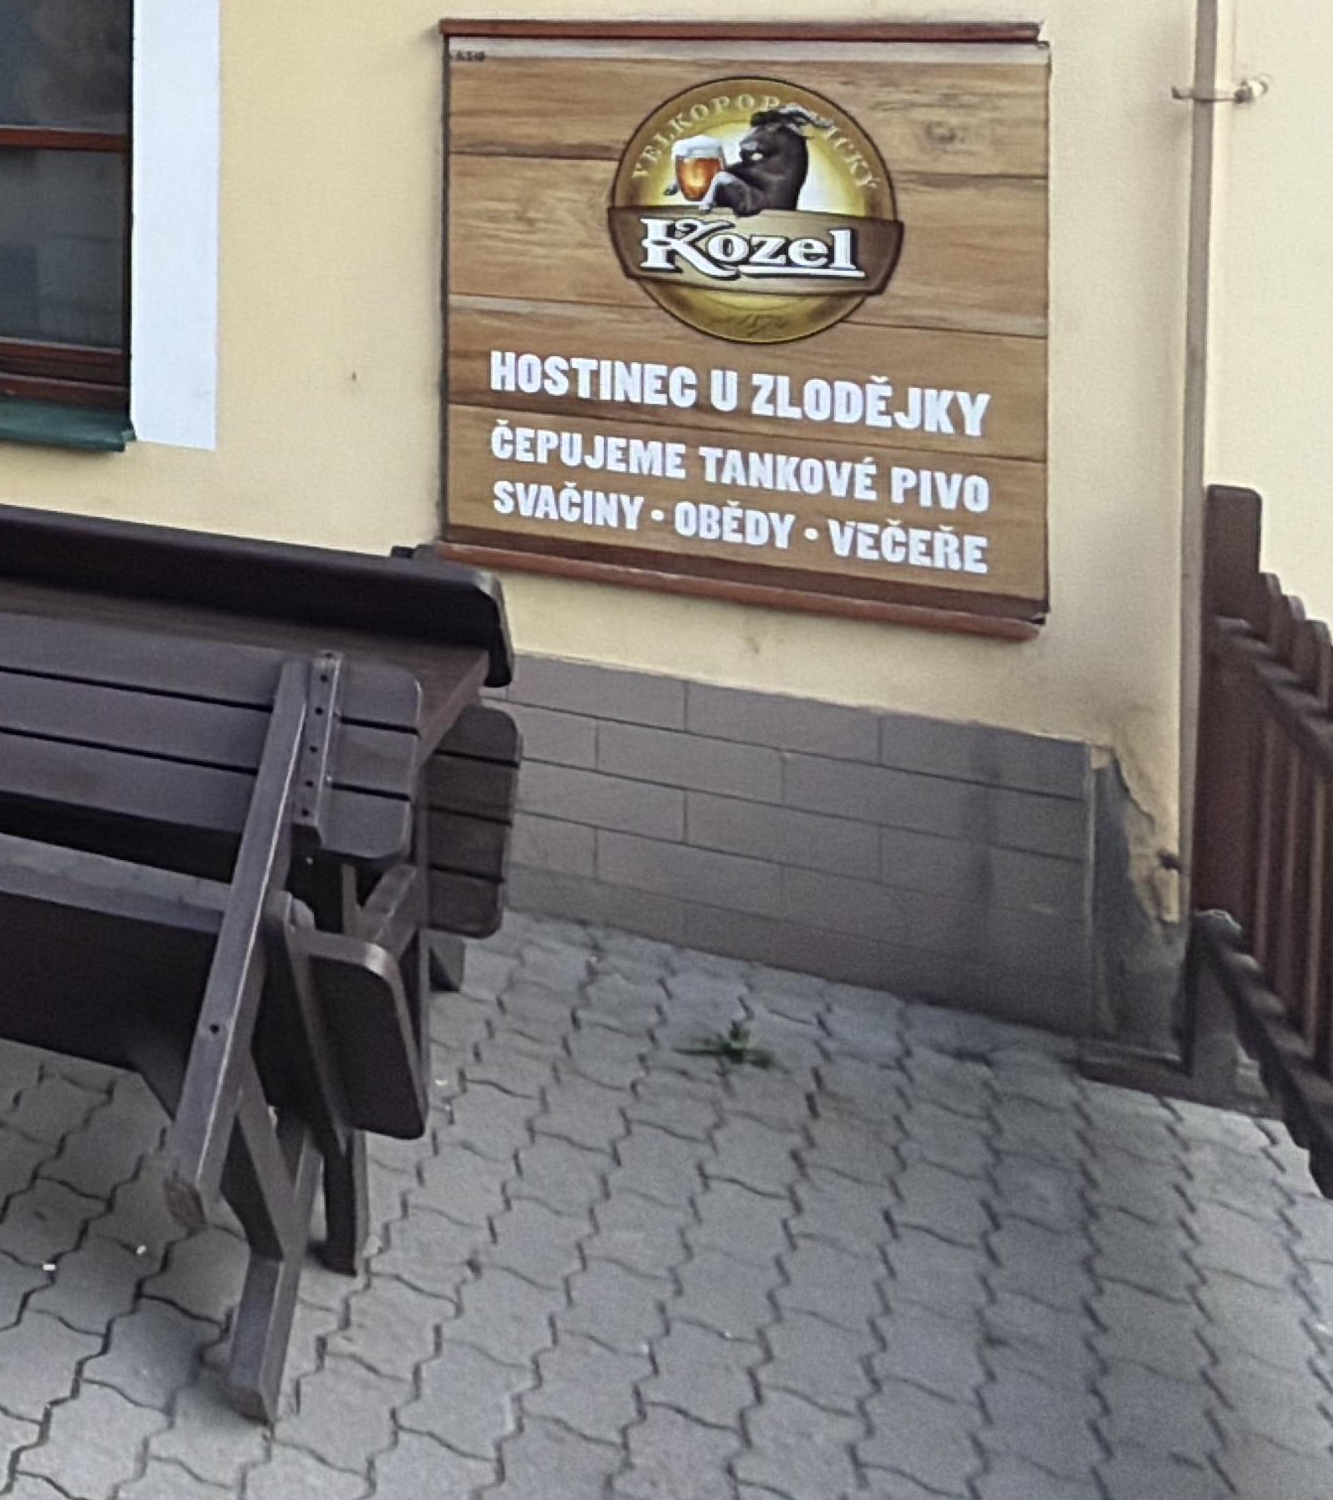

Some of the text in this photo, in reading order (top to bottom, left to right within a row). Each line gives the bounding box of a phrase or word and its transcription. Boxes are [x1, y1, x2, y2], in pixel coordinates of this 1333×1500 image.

[632, 93, 881, 190] VELKOPOPICKÝ
[640, 217, 866, 280] Kozel
[491, 350, 991, 437] HOSTINEC U ZLODĚJKY
[491, 419, 990, 513] ČEPUJEME TANKOVÉ PIVO
[493, 480, 989, 574] SVAČINY OBĚDY VEČEŘE
